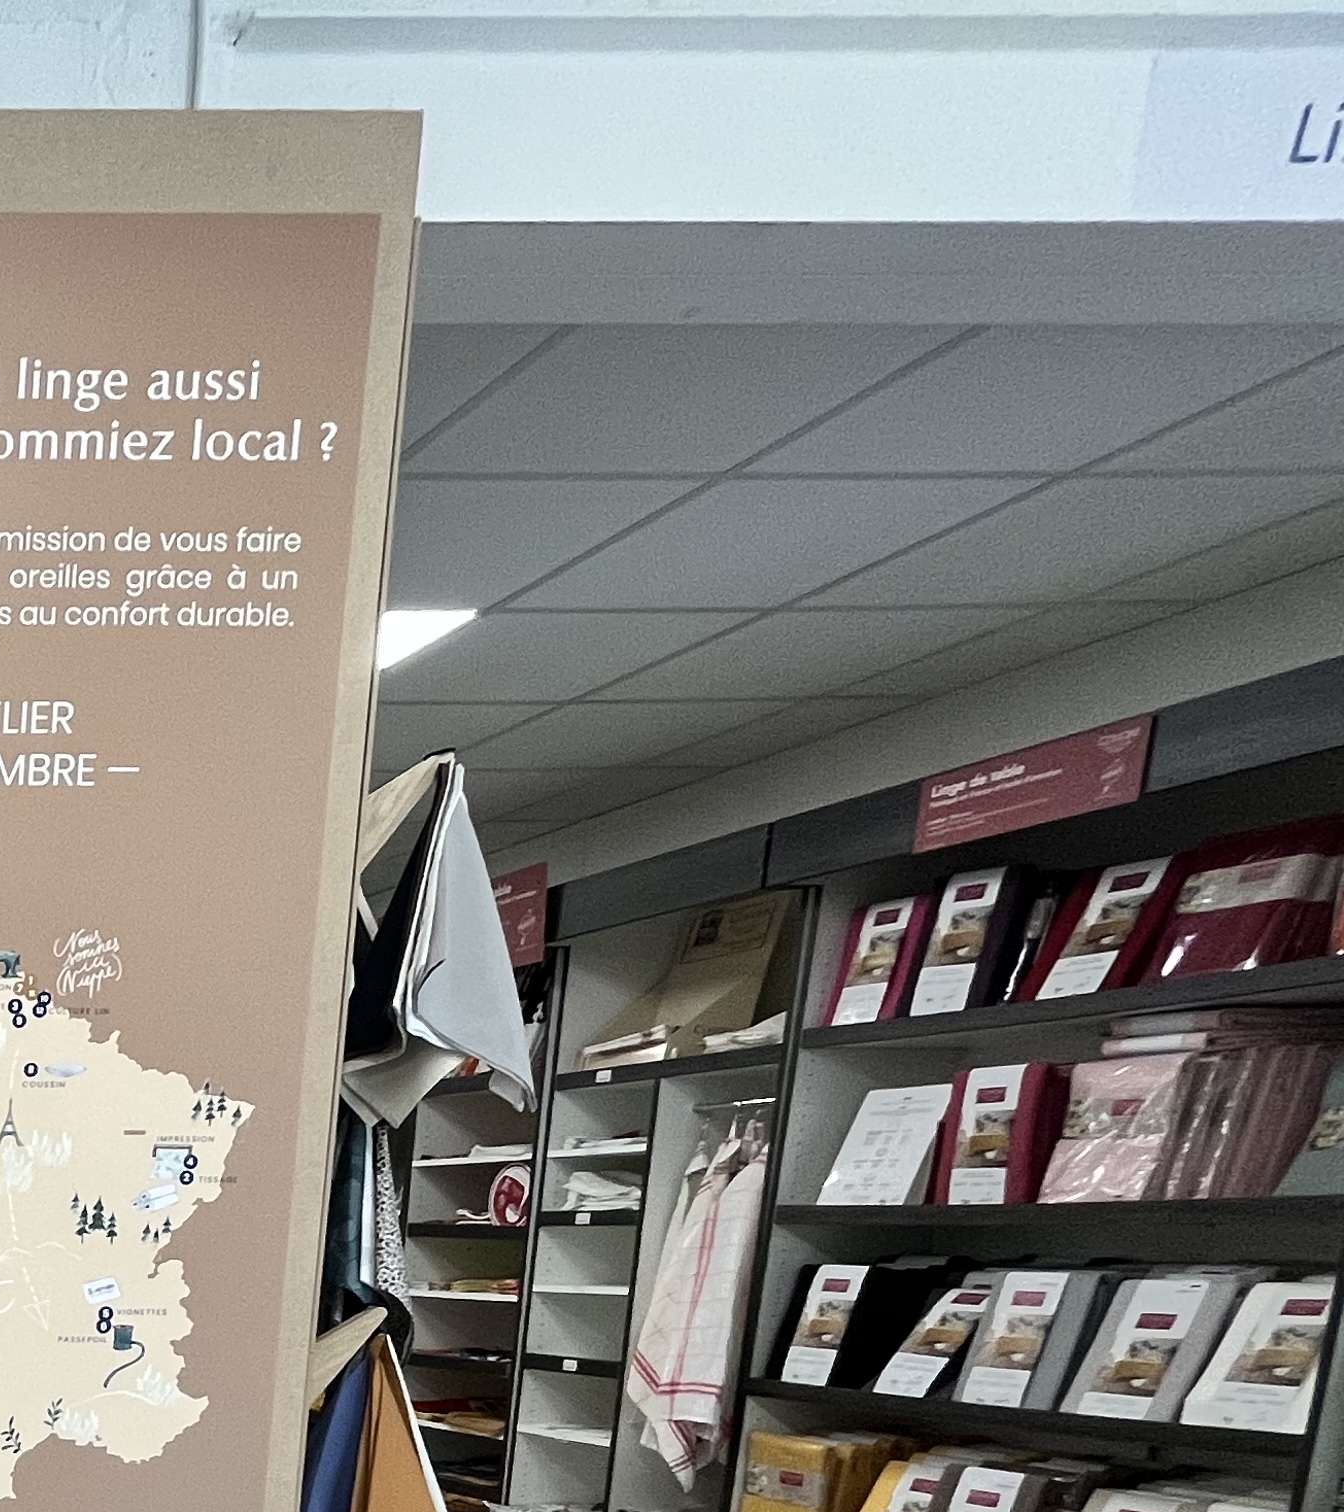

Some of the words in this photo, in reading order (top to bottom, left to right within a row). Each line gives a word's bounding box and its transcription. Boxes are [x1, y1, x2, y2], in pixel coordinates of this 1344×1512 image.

[17, 356, 130, 414] linge
[147, 359, 262, 402] aussi
[191, 418, 303, 463] local
[114, 526, 153, 554] de
[160, 532, 230, 555] vous
[236, 526, 304, 555] faire
[9, 562, 112, 591] oreilles
[126, 563, 213, 598] grâce
[227, 563, 248, 591] à
[262, 570, 300, 591] un
[19, 606, 59, 628] au
[64, 599, 171, 628] confort
[176, 601, 296, 629] durable.
[21, 1080, 67, 1089] COUSSIN
[156, 1135, 215, 1143] IMPRESSION
